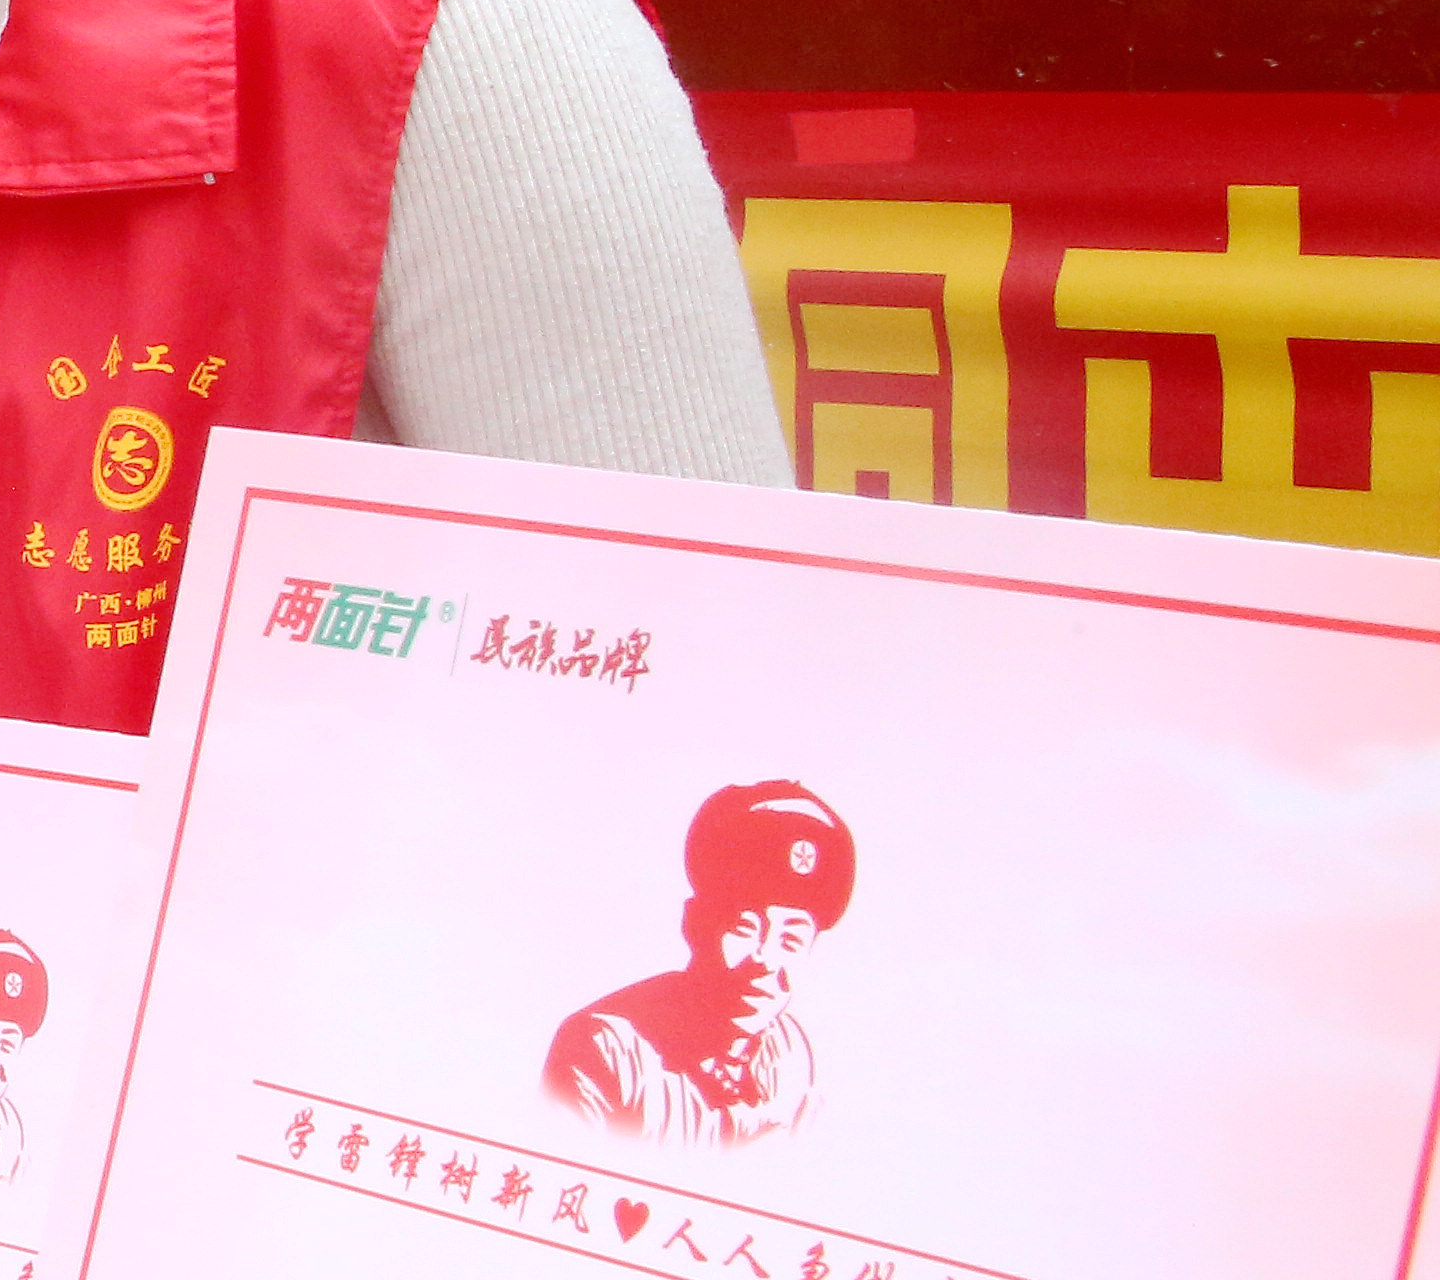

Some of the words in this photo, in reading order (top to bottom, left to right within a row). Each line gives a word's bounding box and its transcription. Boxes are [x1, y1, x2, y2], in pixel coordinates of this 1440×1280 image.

[22, 521, 182, 573] 志愿服务
[85, 614, 159, 650] 两面针
[263, 576, 431, 658] 两面针
[470, 614, 652, 694] 民族品牌
[282, 1108, 591, 1239] 学雷锋树新风
